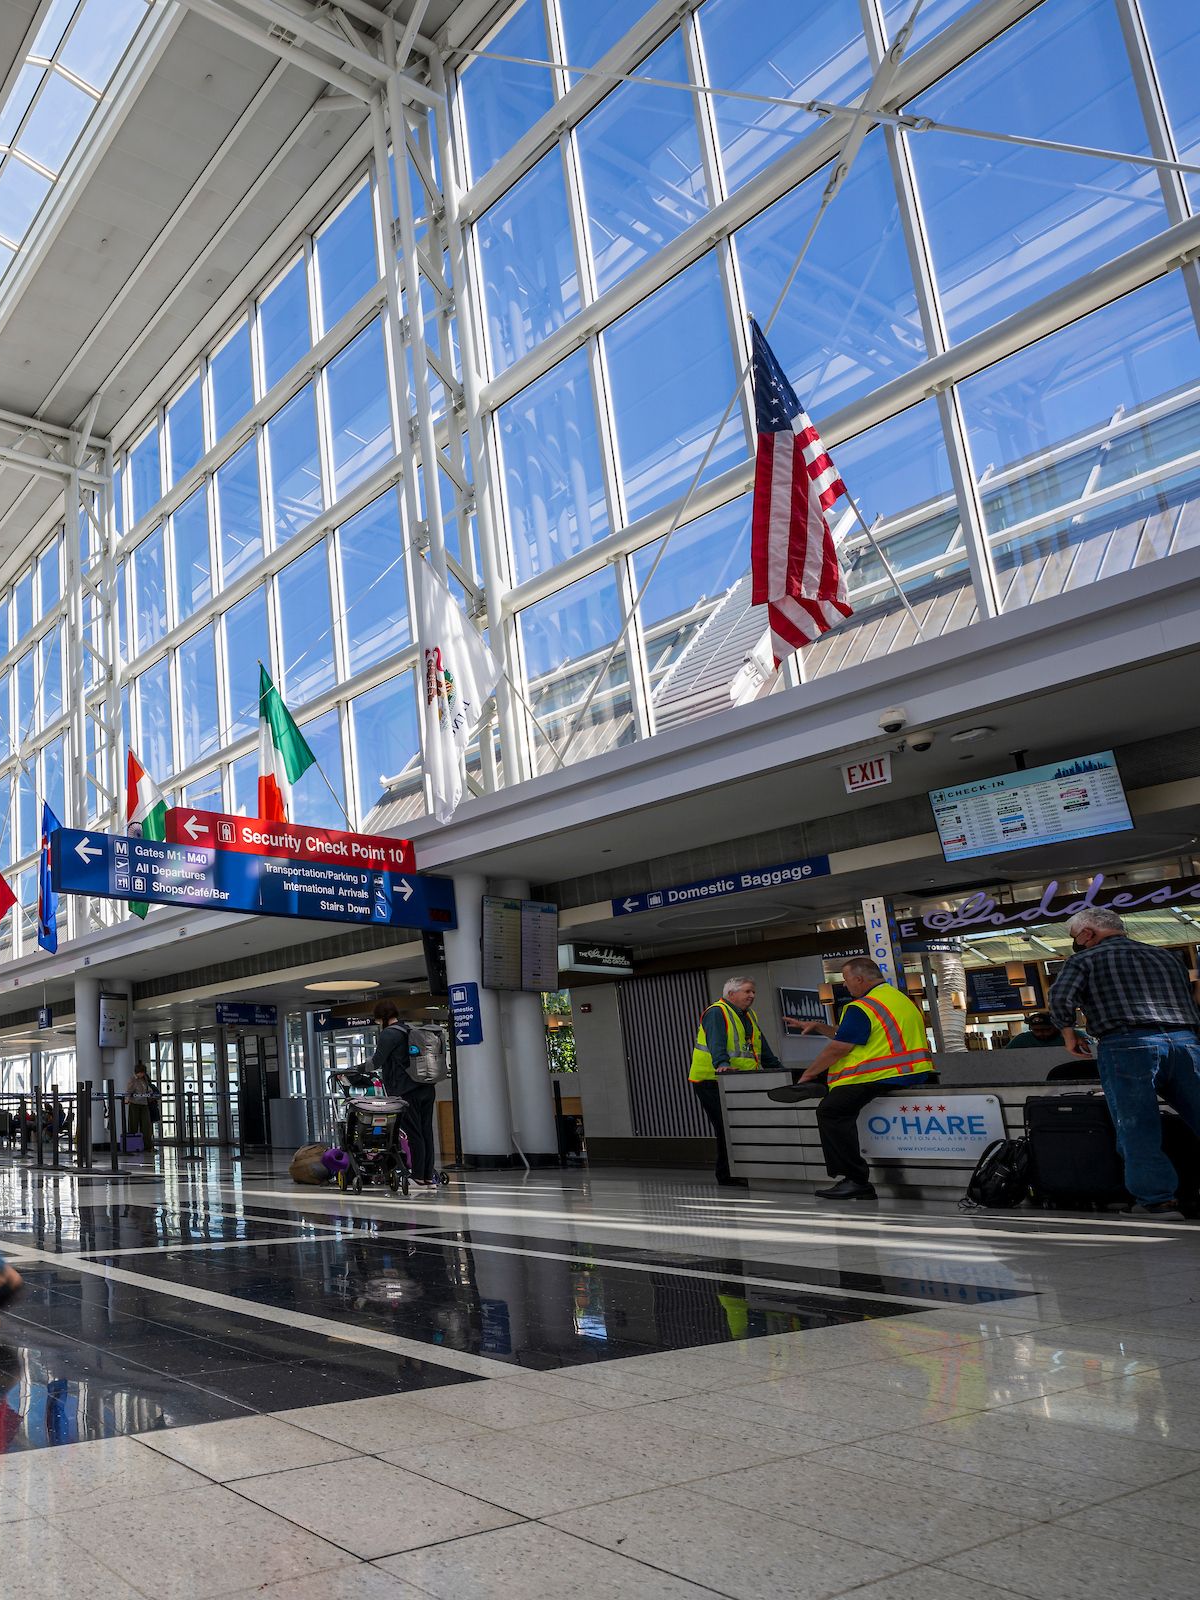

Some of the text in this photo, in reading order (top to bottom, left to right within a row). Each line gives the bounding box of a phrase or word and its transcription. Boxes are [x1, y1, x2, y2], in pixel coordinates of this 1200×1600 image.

[847, 758, 885, 786] EXIT
[947, 780, 1005, 798] CHECK-IN
[135, 845, 165, 859] Gates
[242, 827, 404, 864] Security Check Point 10
[136, 863, 206, 881] All Departures
[264, 862, 368, 884] Transportation/Parking D
[152, 881, 229, 900] Shops/Café/Bar
[283, 881, 369, 899] International Arrivals
[668, 864, 812, 902] Domestic Baggage
[320, 900, 371, 915] Stairs Down
[868, 1115, 987, 1135] O'HARE
